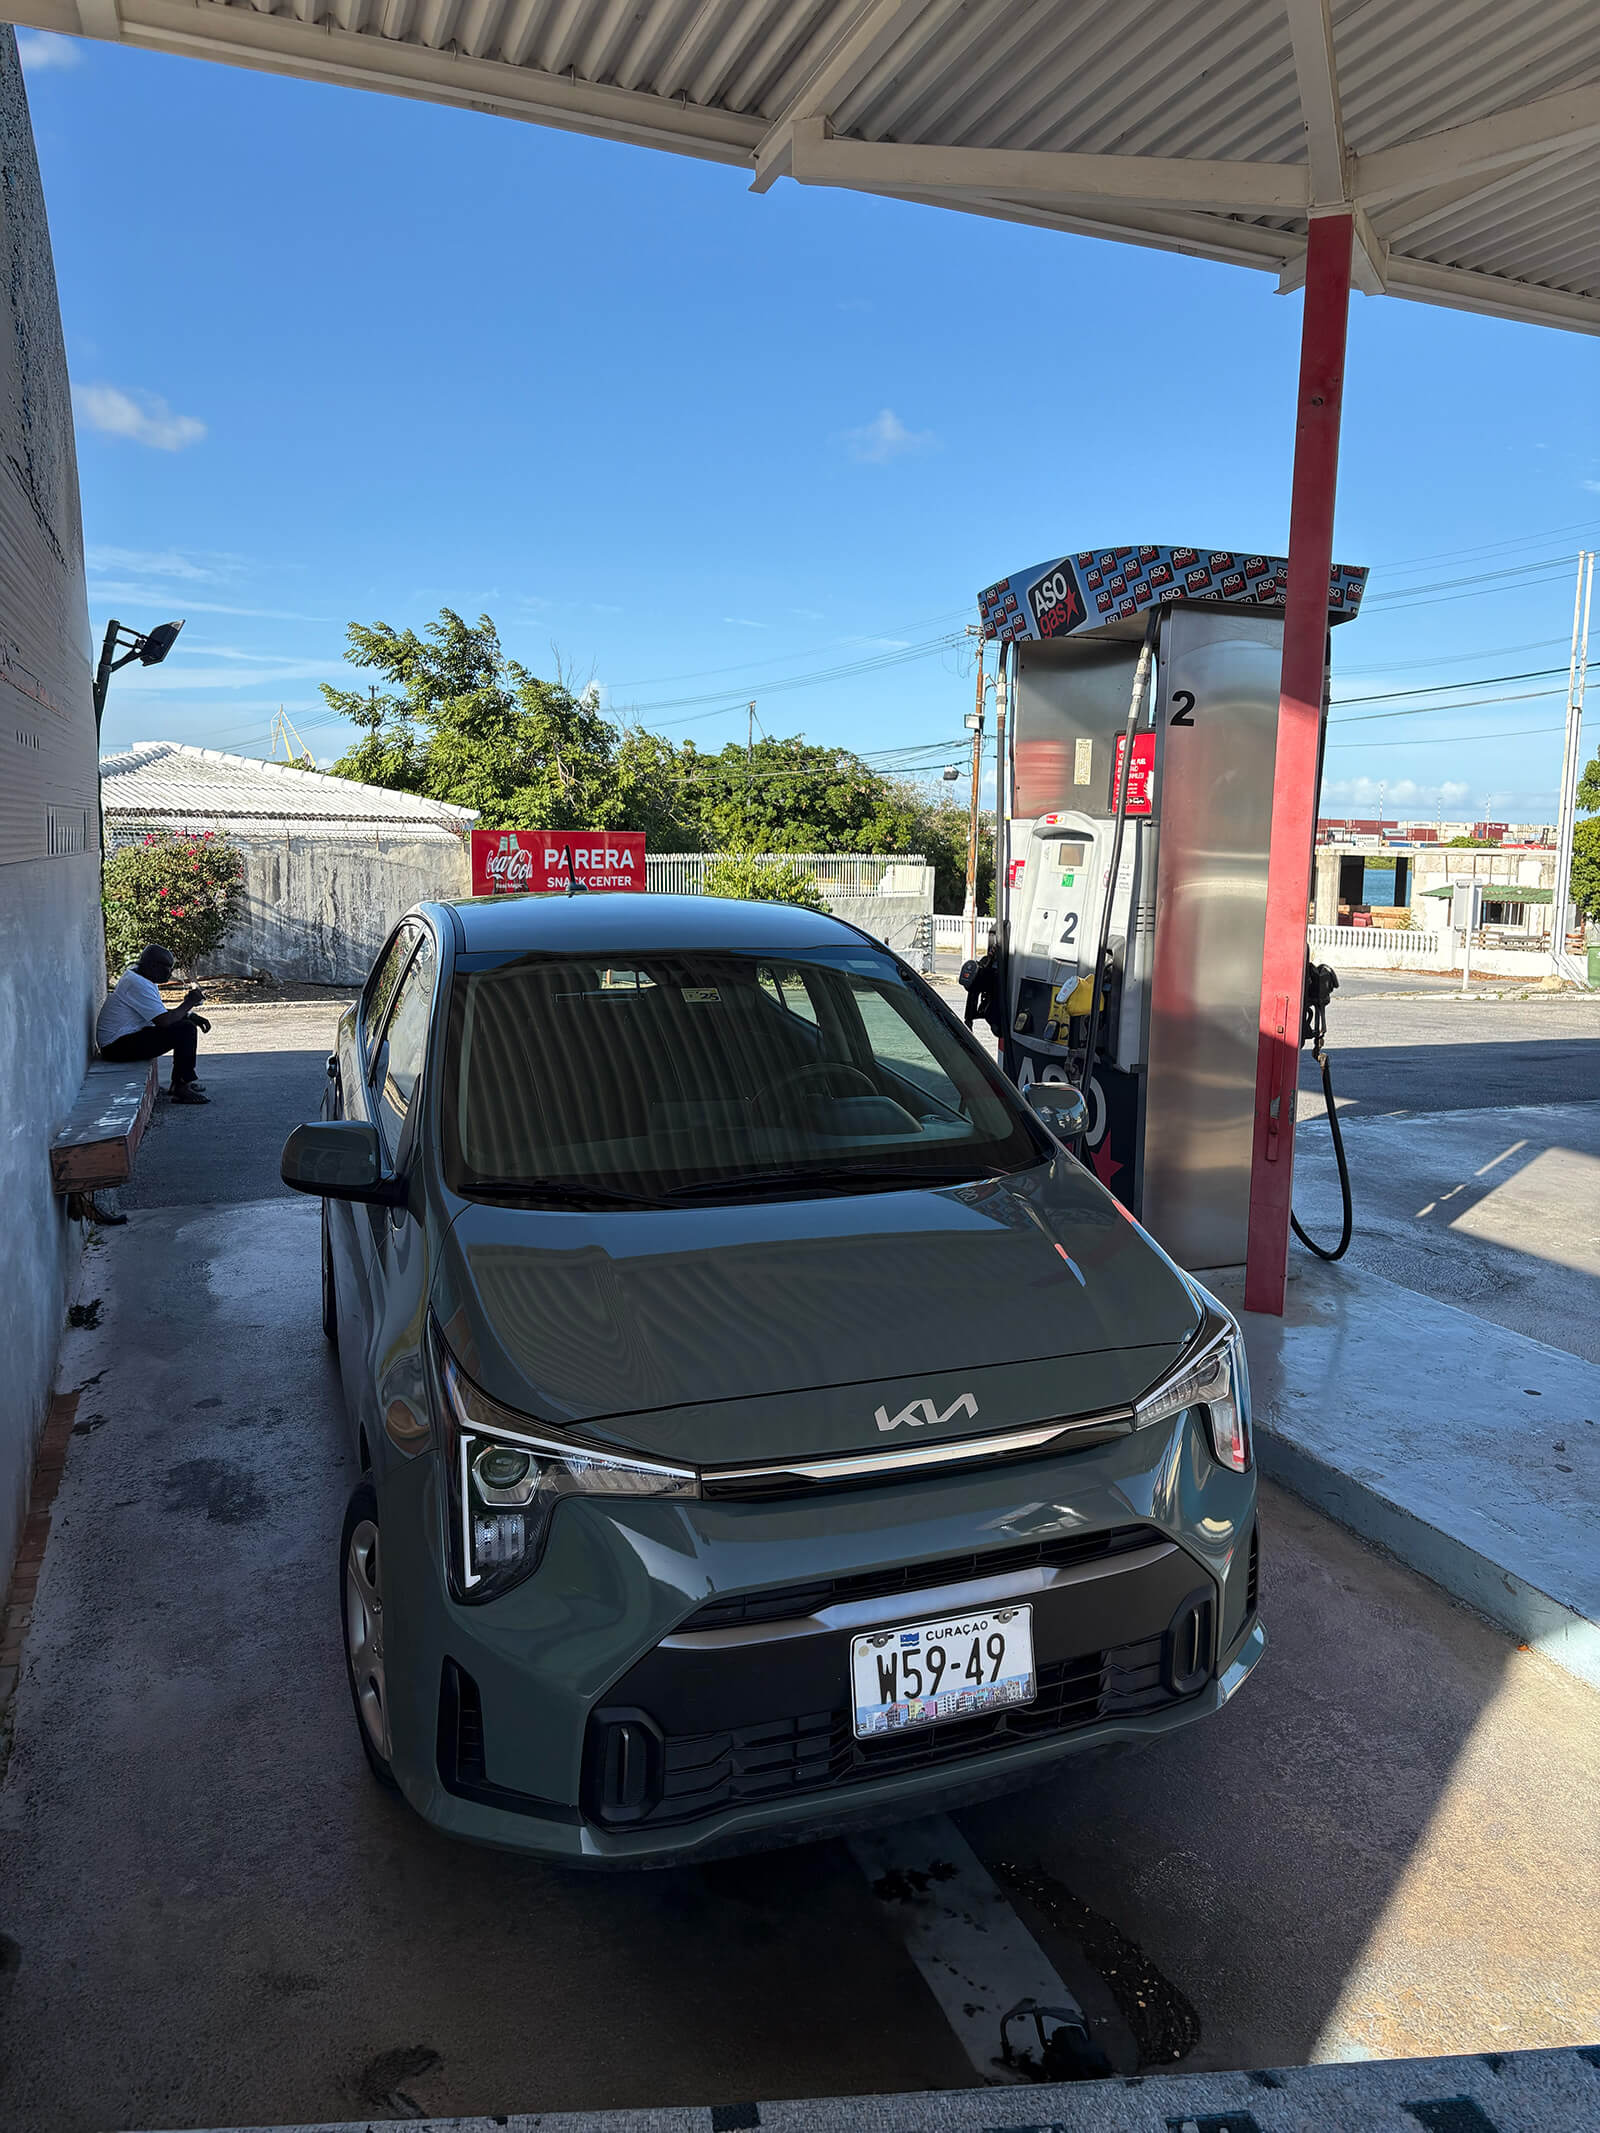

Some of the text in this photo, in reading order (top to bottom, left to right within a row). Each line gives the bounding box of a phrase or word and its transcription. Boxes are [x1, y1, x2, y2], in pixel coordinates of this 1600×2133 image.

[1035, 573, 1067, 618] ASO
[1040, 603, 1067, 640] gas
[1170, 690, 1196, 727] 2
[544, 848, 635, 870] PARERA
[547, 876, 632, 888] SNAK CENTER
[1060, 912, 1078, 944] 2
[874, 1392, 979, 1432] KIA
[926, 1621, 988, 1641] CURAÇAO
[876, 1632, 1006, 1705] W59-49
